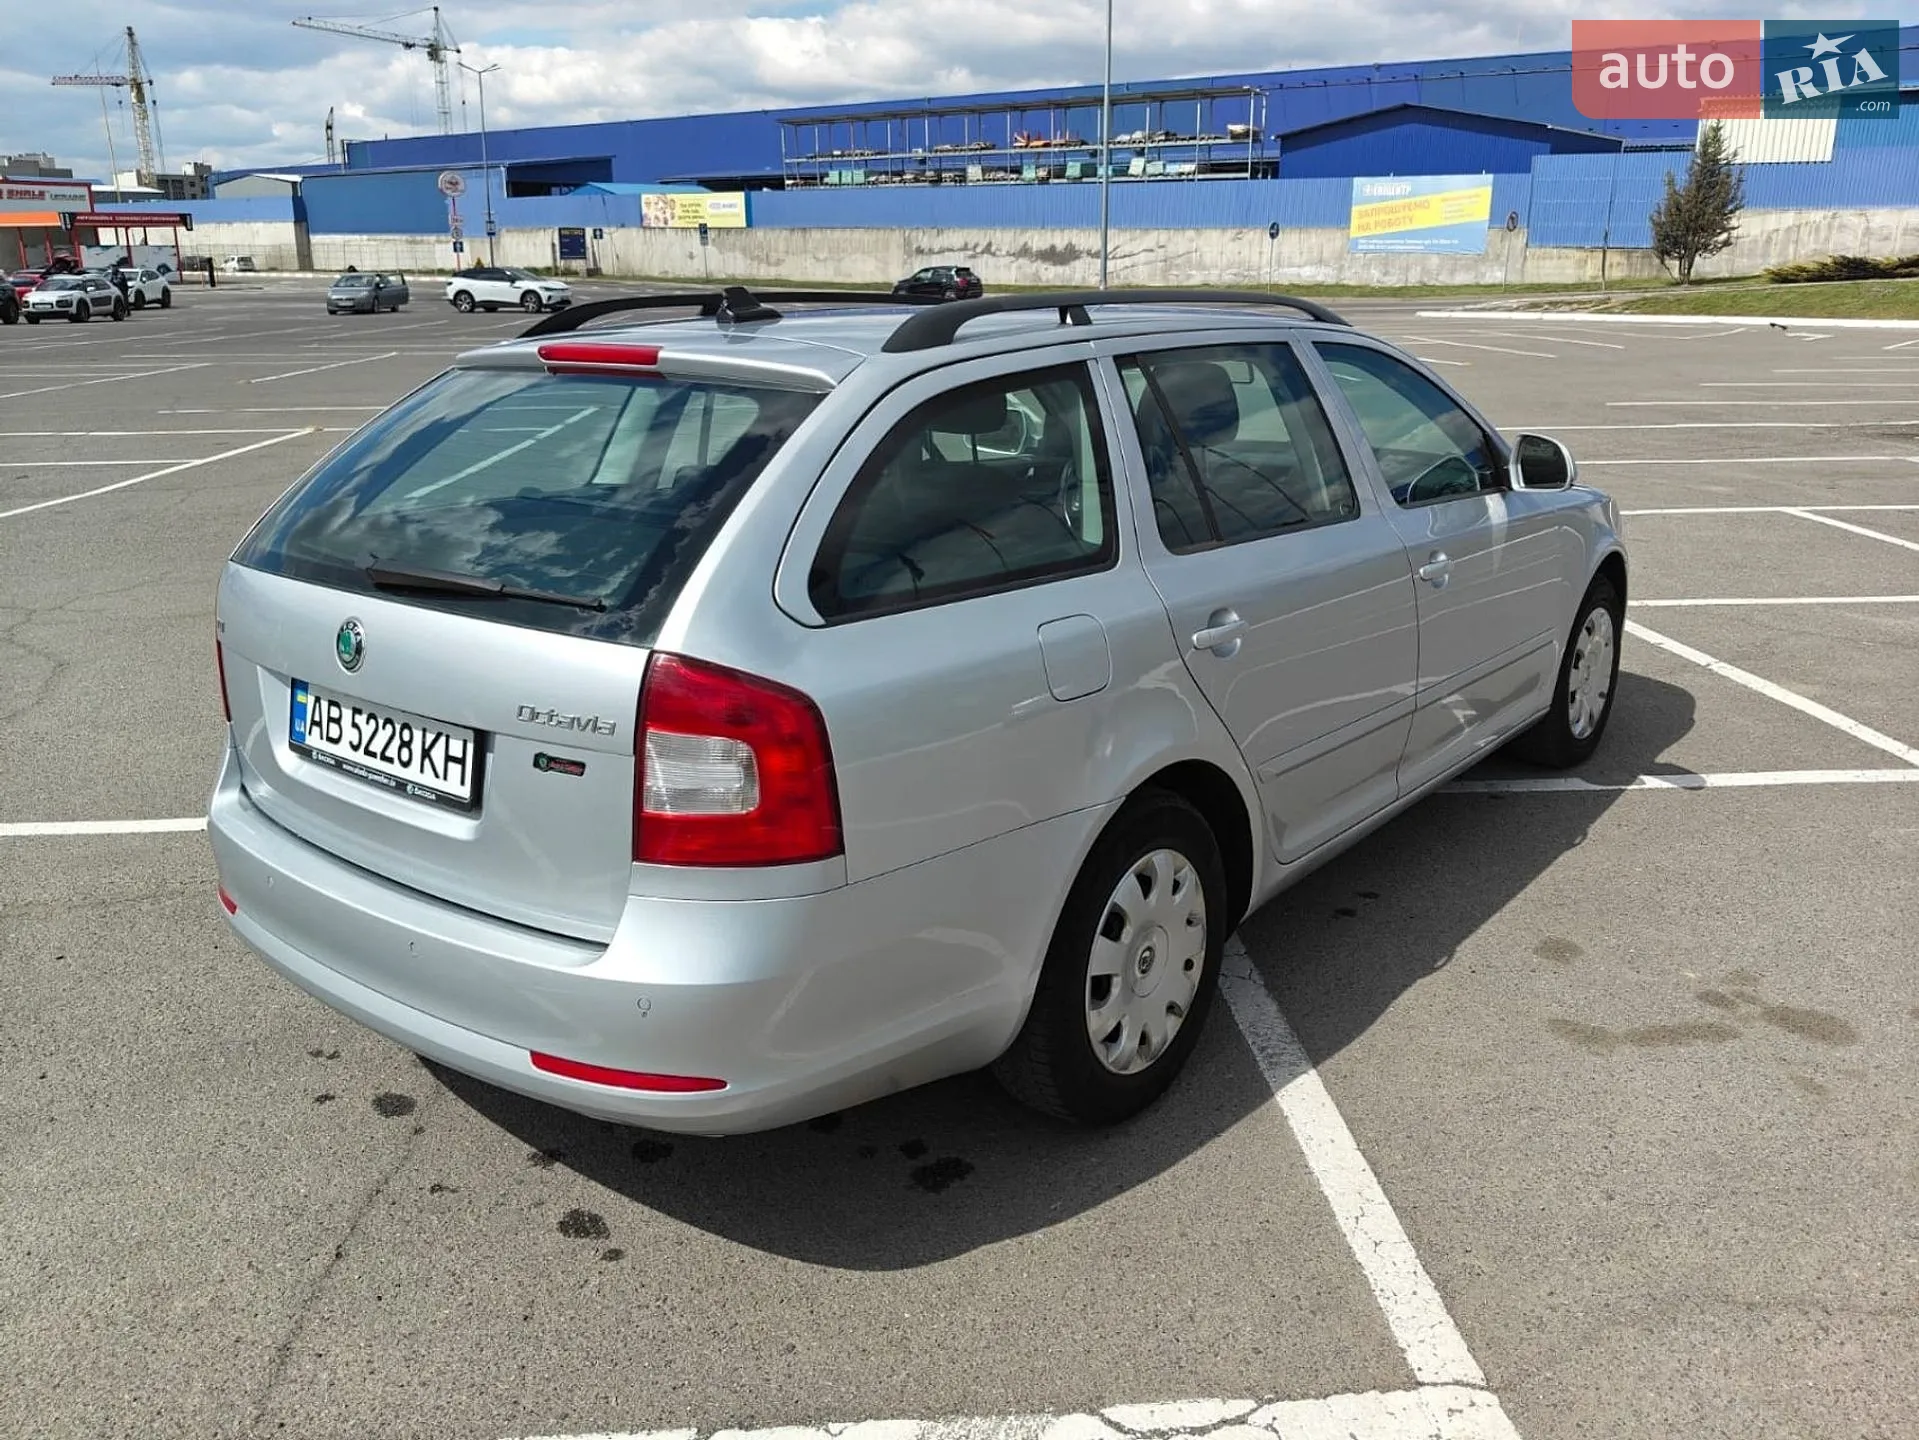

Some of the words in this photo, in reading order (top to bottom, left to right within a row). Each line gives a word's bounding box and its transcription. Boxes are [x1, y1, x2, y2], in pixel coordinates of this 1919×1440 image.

[294, 719, 306, 733] UA
[517, 704, 617, 737] Octavia
[308, 695, 343, 745] AB
[349, 706, 414, 769] 5228
[419, 727, 468, 787] KH
